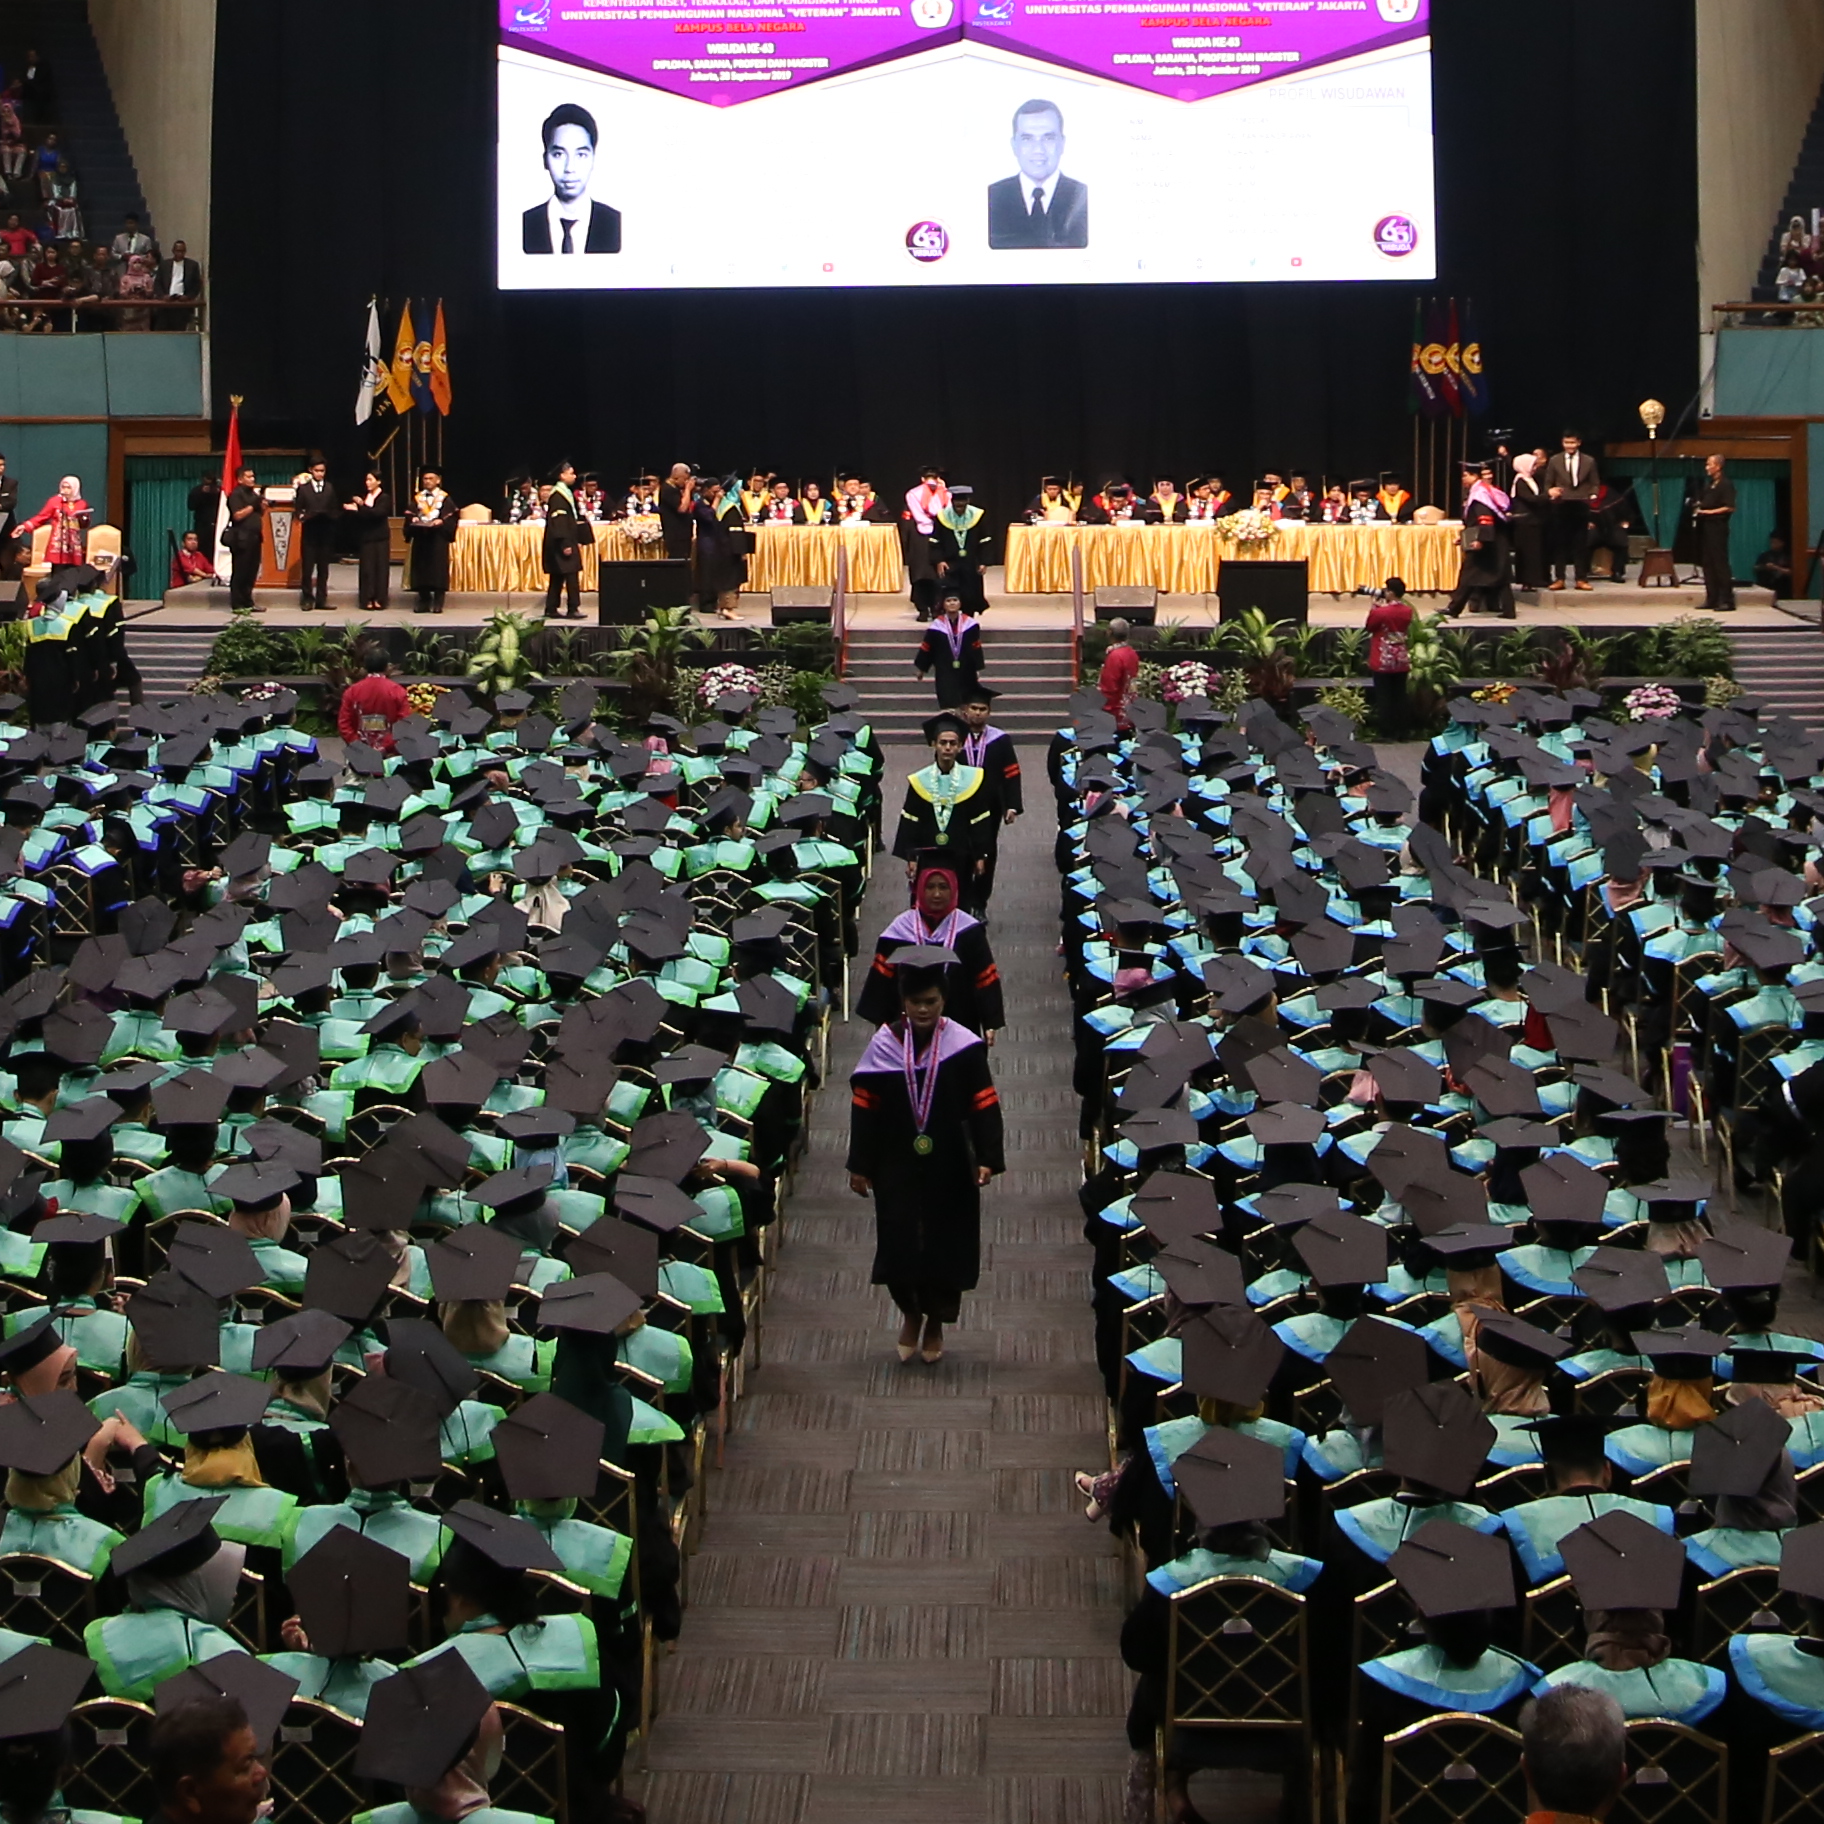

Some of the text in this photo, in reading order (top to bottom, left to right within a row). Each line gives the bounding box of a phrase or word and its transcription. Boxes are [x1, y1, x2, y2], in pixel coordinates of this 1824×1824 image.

[561, 7, 901, 20] UNIVERSITAS PEMBANGUNAN NASIONAL "VETERAN" JAKARTA
[1025, 1, 1366, 14] UNIVERSITAS PEMBANGUNAN NASIONAL "VETERAN" JAKARTA
[674, 22, 806, 33] KAMPUS BELA NEGARA
[1140, 16, 1272, 28] KAMPUS BELA NEGARA
[706, 43, 774, 54] WISUDA KE-63
[1172, 37, 1240, 48] WISUDA KE-63
[1270, 88, 1404, 100] PROFIL WISUDAWAN
